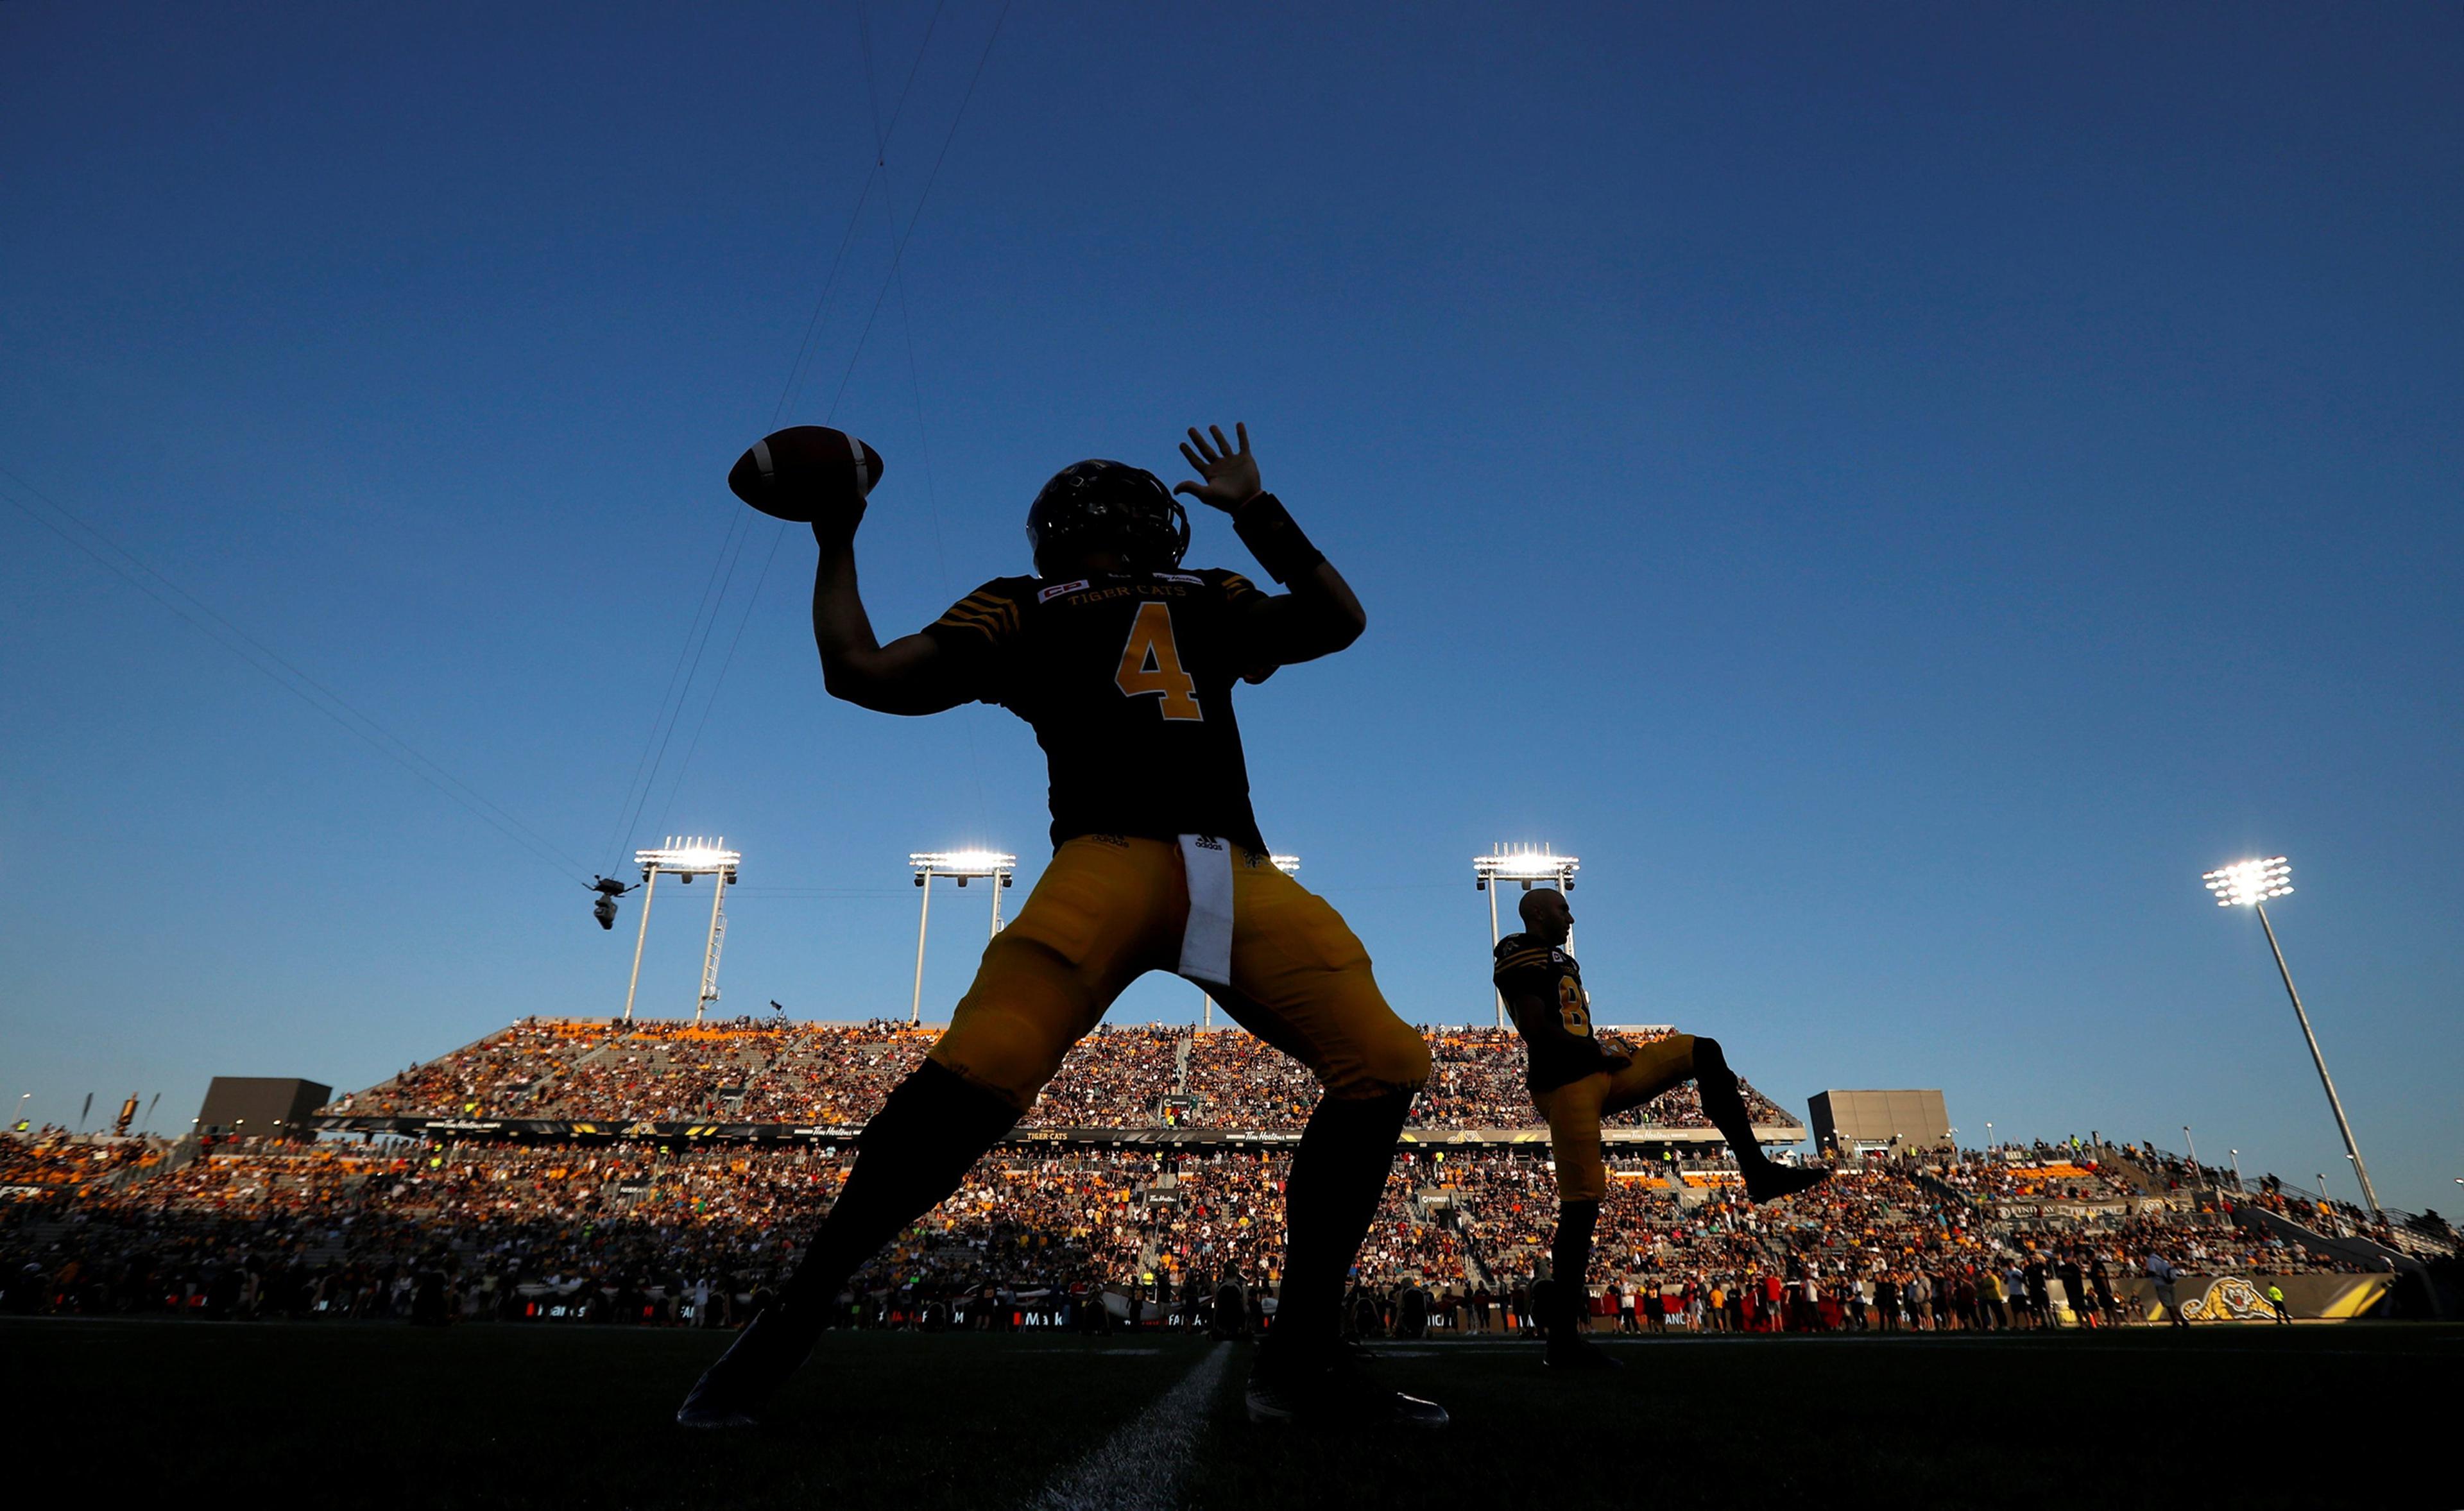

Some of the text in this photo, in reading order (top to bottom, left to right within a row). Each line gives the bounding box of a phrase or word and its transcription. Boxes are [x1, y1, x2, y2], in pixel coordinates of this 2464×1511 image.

[1068, 585, 1186, 606] TIGER-CATS
[1115, 601, 1204, 722] 4
[1092, 834, 1129, 848] adidas
[1195, 840, 1223, 851] adidas
[812, 1125, 852, 1136] Tim Hortons
[1245, 1131, 1285, 1141] Tim Hortons
[1027, 1132, 1068, 1141] TIGER-CATS
